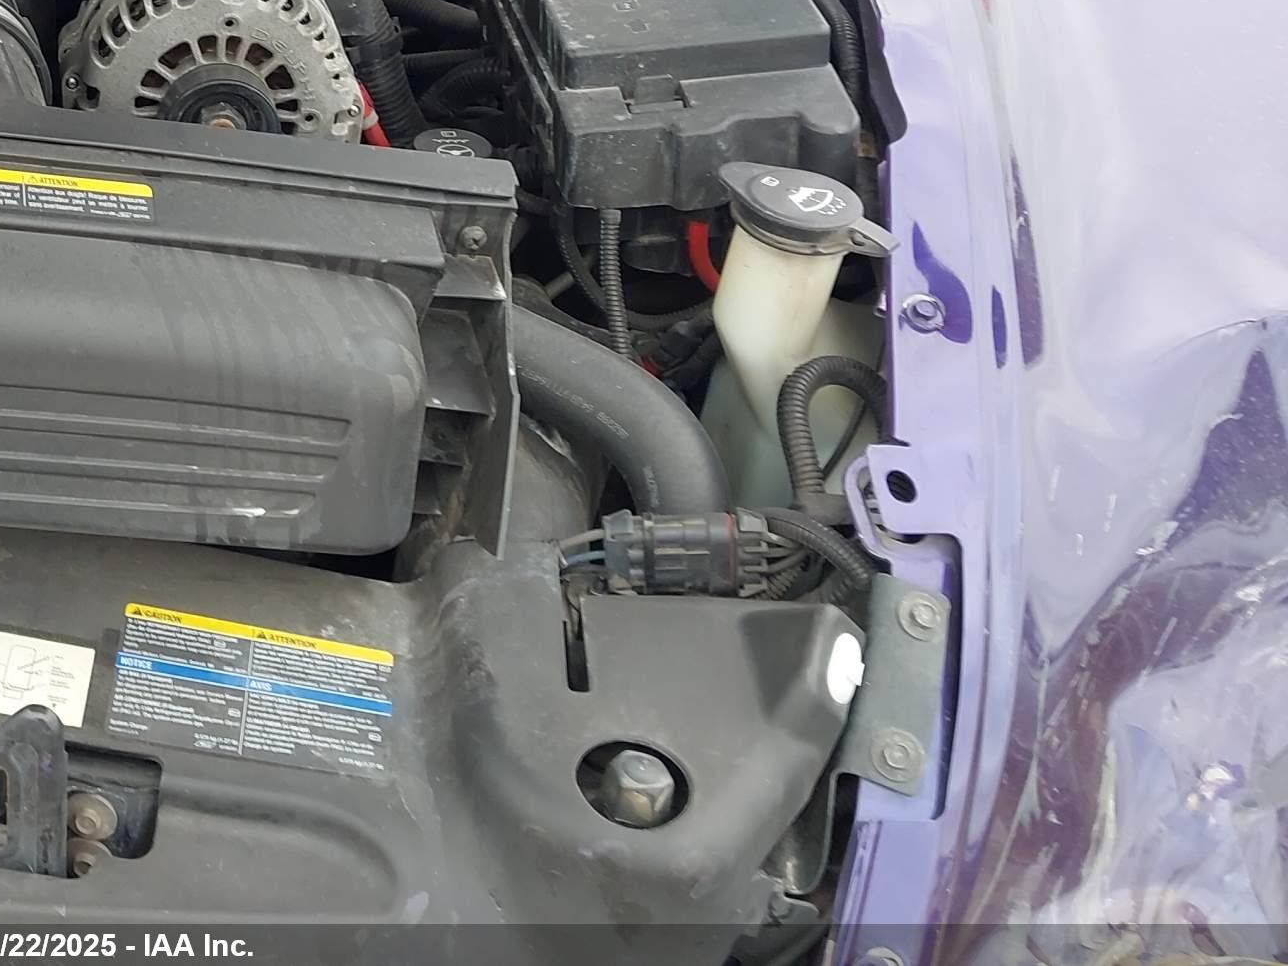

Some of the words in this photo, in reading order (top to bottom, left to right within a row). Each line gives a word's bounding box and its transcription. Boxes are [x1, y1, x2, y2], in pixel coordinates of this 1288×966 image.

[40, 177, 79, 187] ATTENTION
[145, 610, 183, 624] CAUTION
[269, 633, 317, 649] ATTENTION
[120, 656, 153, 669] NOTICE
[250, 680, 272, 691] AVIS
